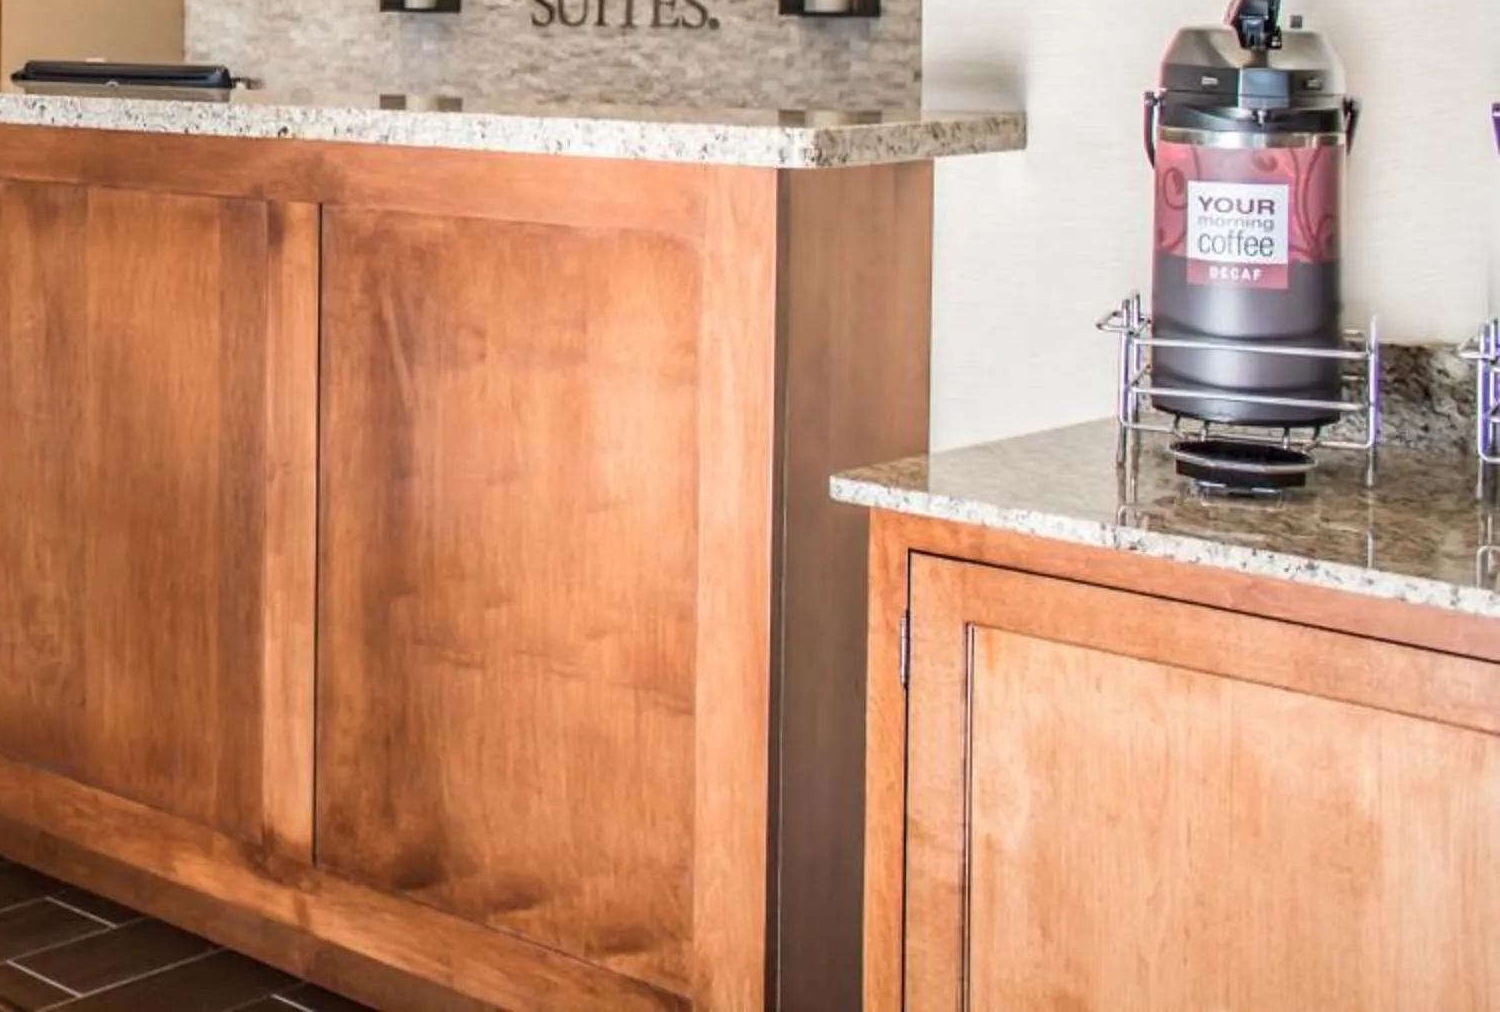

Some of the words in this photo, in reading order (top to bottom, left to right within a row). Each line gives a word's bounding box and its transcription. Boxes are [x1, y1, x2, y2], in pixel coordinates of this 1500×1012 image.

[1198, 196, 1276, 215] YOUR
[1197, 215, 1276, 232] morning
[1197, 230, 1275, 257] coffee
[1209, 265, 1263, 281] DECAF
